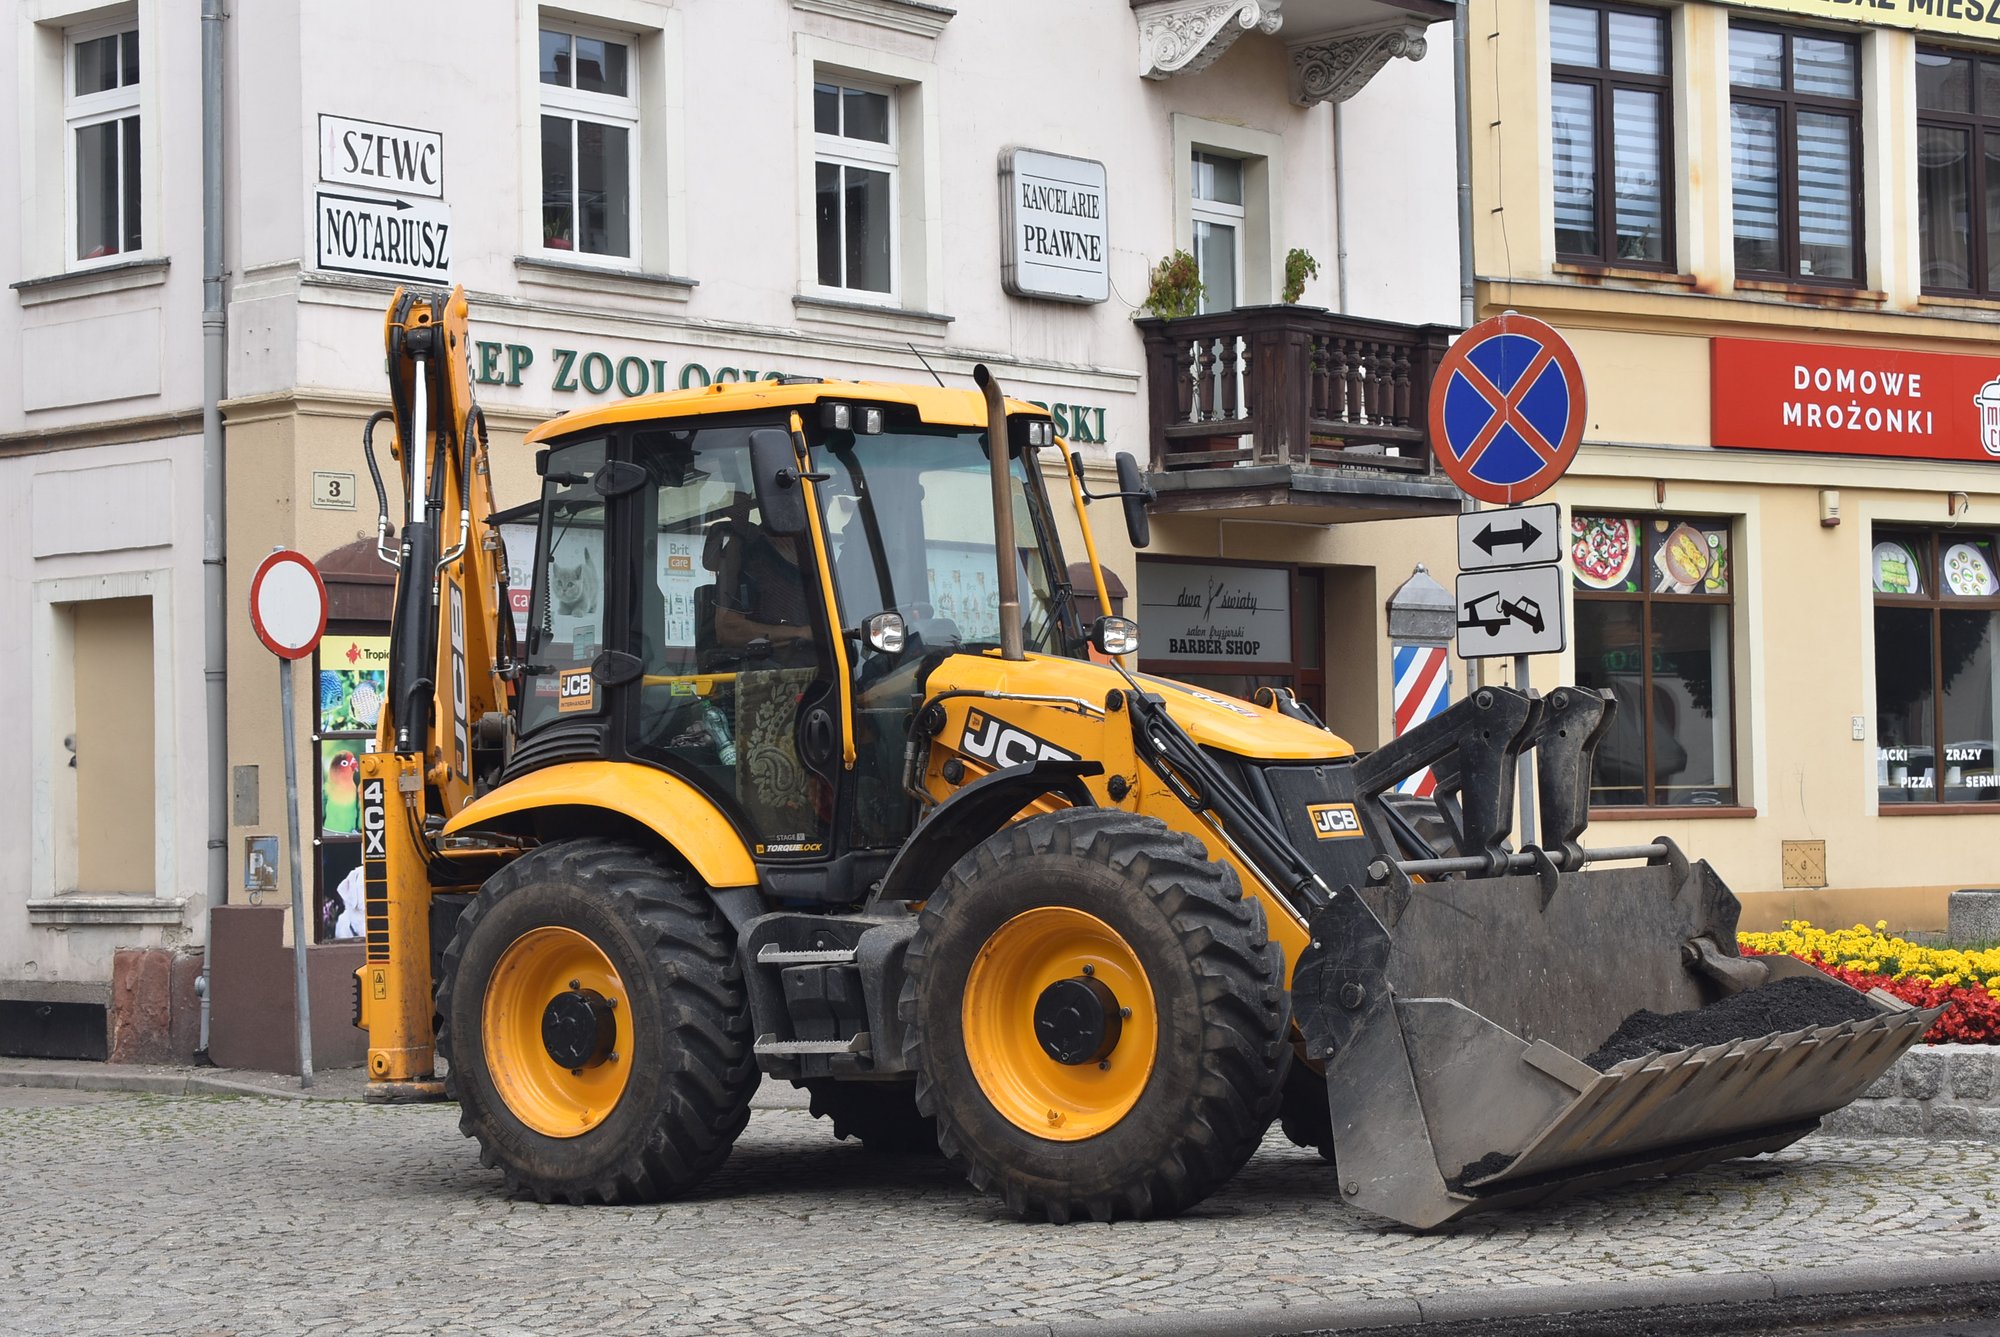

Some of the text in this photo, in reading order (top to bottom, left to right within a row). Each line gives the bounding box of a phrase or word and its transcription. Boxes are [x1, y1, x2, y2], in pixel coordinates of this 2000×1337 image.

[343, 131, 437, 185] SZEWC
[1022, 183, 1099, 219] KANCELARIE
[326, 208, 449, 271] NOTARIUSZ
[1023, 225, 1101, 262] PRAWNE
[1794, 365, 1921, 397] DOMOWE
[1783, 400, 1932, 434] MROŻONKI
[329, 480, 341, 497] 3
[669, 543, 689, 555] Brit
[671, 558, 689, 567] care
[511, 567, 531, 586] Br
[1177, 587, 1258, 615] dwa światy
[1186, 625, 1245, 640] salon fryzjerski
[1169, 639, 1260, 655] BARBER SHOP
[451, 586, 468, 777] JCB
[562, 674, 591, 698] JCB
[1946, 749, 1982, 760] ZRAZY
[1901, 775, 2000, 788] PIZZA SERNI
[364, 782, 385, 853] 4CX
[1318, 810, 1357, 831] JCB
[767, 844, 822, 852] TORQUELOCK
